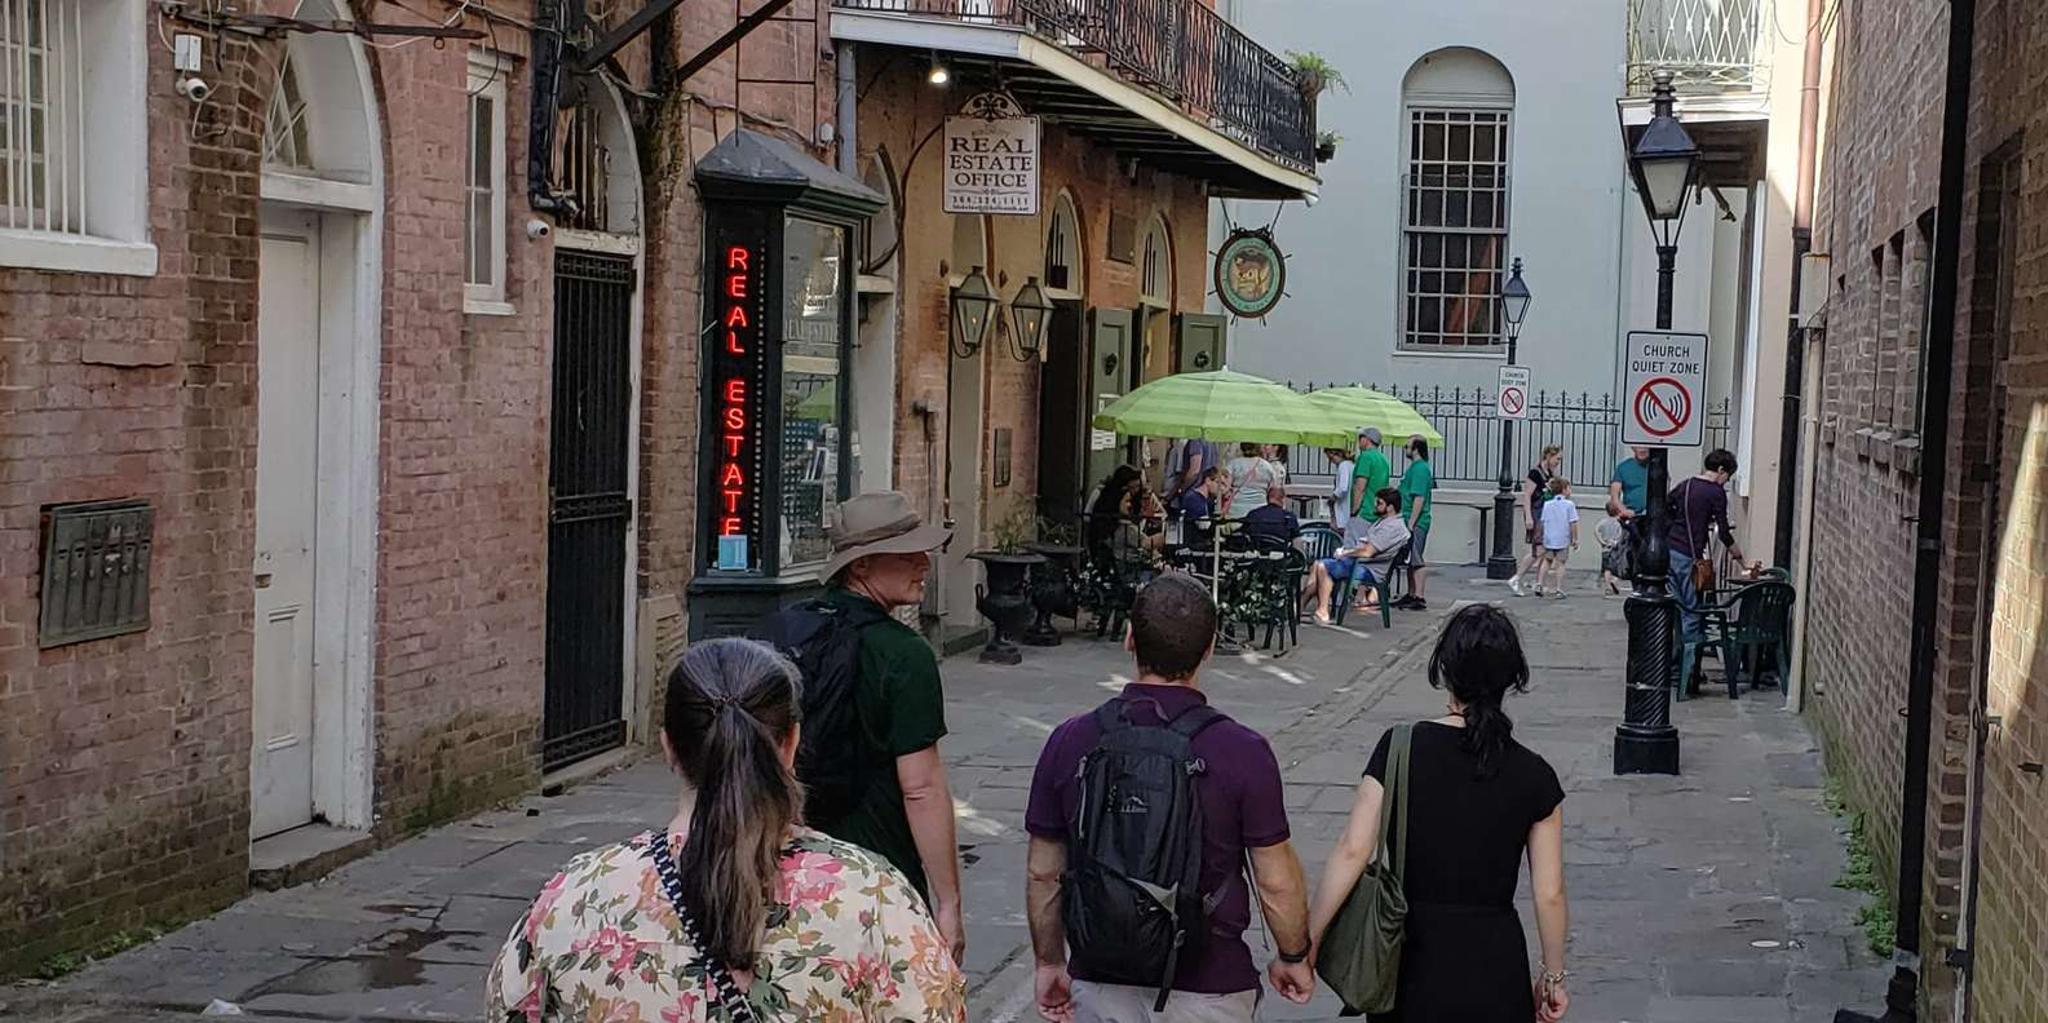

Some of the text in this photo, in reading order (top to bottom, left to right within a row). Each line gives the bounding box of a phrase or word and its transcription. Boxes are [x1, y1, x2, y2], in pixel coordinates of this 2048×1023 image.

[951, 137, 1033, 154] REAL
[950, 154, 1032, 171] ESTATE
[954, 172, 1028, 187] OFFICE
[1643, 344, 1690, 358] CHURCH
[1632, 361, 1701, 375] QUIET ZONE
[723, 247, 749, 537] REAL ESTATE
